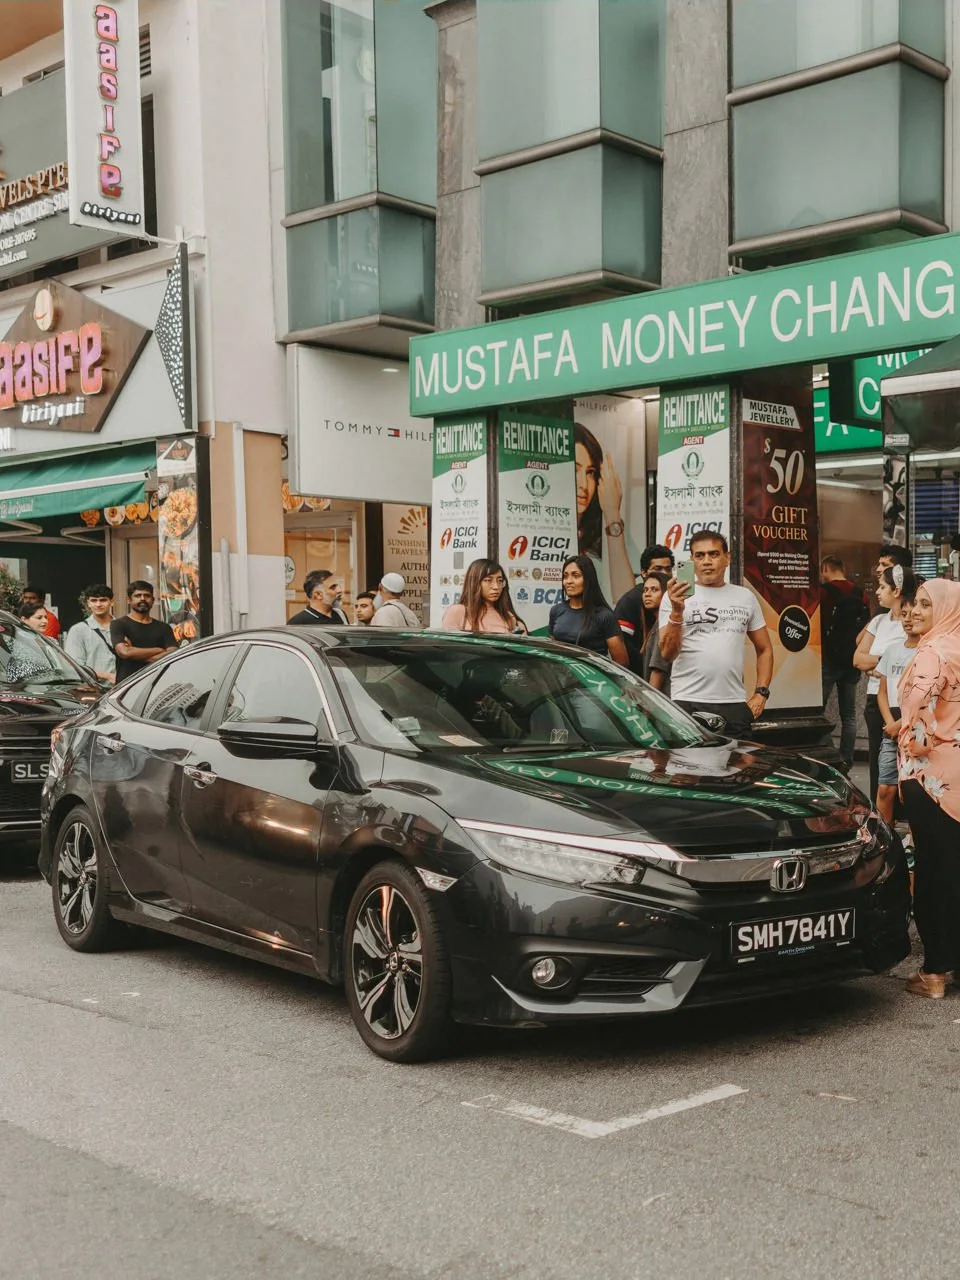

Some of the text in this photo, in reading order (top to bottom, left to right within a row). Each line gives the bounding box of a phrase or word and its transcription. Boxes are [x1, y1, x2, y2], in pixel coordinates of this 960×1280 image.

[81, 202, 141, 225] biriyani
[414, 329, 579, 399] MUSTAFA
[602, 295, 757, 370] MONEY
[21, 396, 85, 425] biriyani
[664, 391, 725, 428] REMITTANCE
[749, 401, 788, 416] MUSTAFA
[750, 412, 794, 427] JEWELLERY
[324, 419, 382, 436] TOMMY
[436, 422, 483, 454] REMITTANCE
[503, 421, 570, 456] REMITTANCE
[683, 436, 704, 445] AGENT
[526, 461, 548, 470] AGENT
[772, 505, 808, 525] GIFT
[454, 526, 478, 537] ICICI
[752, 525, 808, 540] VOUCHER
[387, 539, 425, 547] SUNSHINE
[452, 538, 478, 549] Bank
[532, 536, 571, 549] ICICI
[390, 547, 423, 556] TRAVELS
[529, 549, 570, 562] Bank
[785, 626, 802, 639] Offer
[738, 912, 850, 952] SMH7841Y
